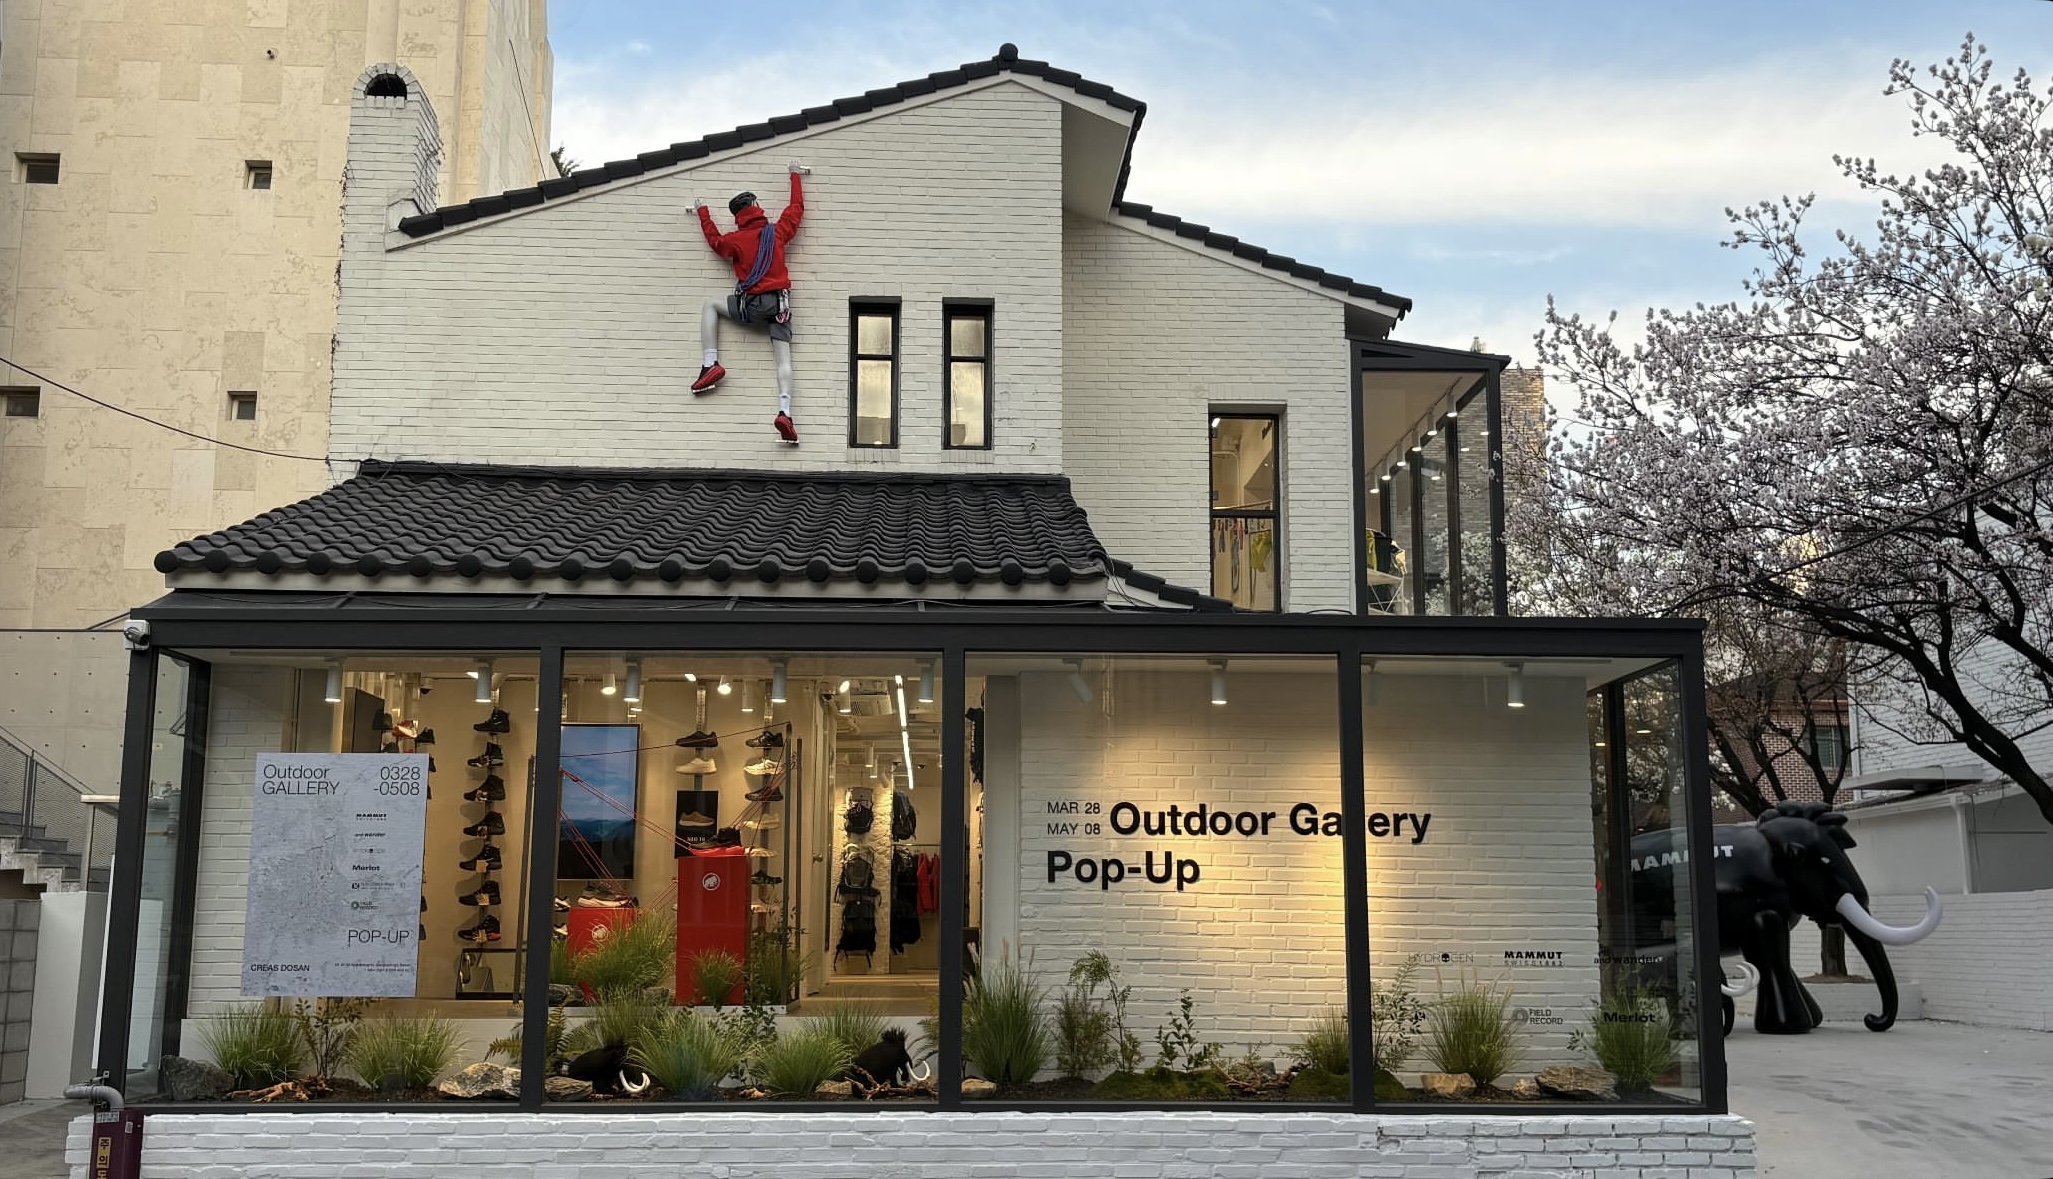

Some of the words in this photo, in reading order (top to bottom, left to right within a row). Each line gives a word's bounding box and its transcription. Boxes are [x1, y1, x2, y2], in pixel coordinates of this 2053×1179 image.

[263, 764, 330, 779] Outdoor
[380, 766, 421, 781] 0328
[262, 781, 340, 796] GALLERY
[373, 781, 420, 796] -0508
[1046, 801, 1079, 815] MAR
[1084, 801, 1100, 814] 28
[1046, 823, 1079, 835] MAY
[1084, 823, 1101, 835] 08
[1109, 801, 1276, 836] Outdoor
[1289, 802, 1432, 844] Gaery
[1046, 850, 1200, 891] Pop-Up
[348, 929, 410, 944] POP-UP
[1504, 950, 1563, 960] MAMMUT
[250, 964, 280, 972] CREAS
[281, 964, 310, 972] DOSAN
[1529, 1009, 1552, 1017] FIELD
[1603, 1012, 1656, 1023] Merlot
[1529, 1017, 1564, 1025] RECORD
